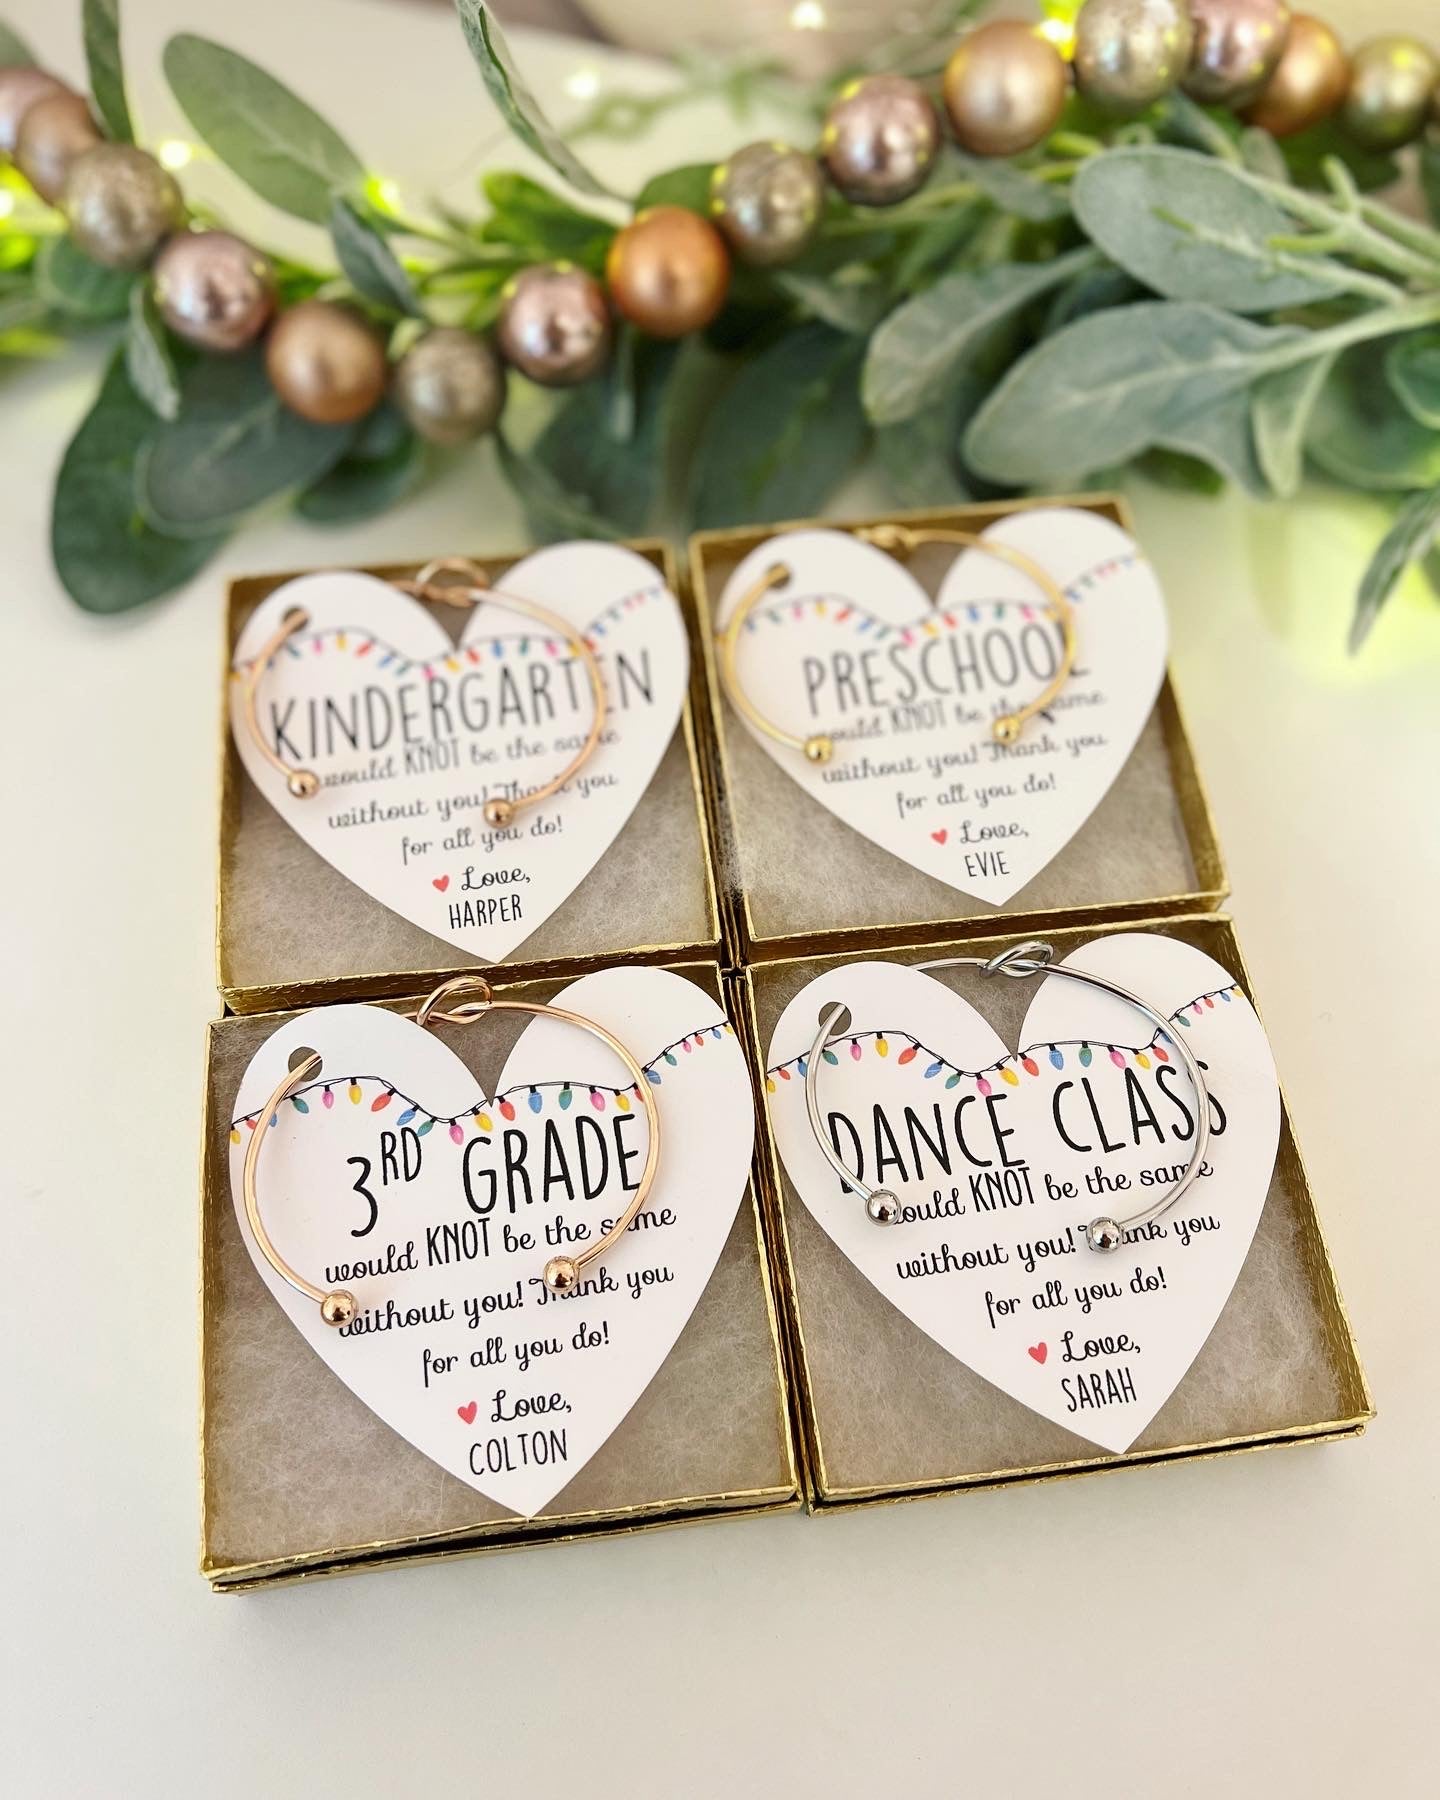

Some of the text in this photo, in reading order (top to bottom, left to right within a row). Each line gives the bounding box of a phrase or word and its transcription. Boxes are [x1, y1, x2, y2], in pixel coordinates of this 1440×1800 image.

[890, 697, 946, 734] KNOT
[956, 704, 983, 724] be
[323, 757, 397, 787] would
[405, 737, 459, 775] KNOT
[470, 744, 498, 765] be
[506, 737, 545, 760] the
[822, 734, 1107, 784] without you! Thank you
[328, 800, 428, 829] without
[437, 786, 487, 821] you!
[577, 773, 618, 798] you
[897, 773, 1057, 819] for all you do!
[402, 815, 563, 866] for all you do!
[960, 820, 1029, 844] Love,
[461, 866, 531, 891] Love,
[965, 851, 1010, 878] EVIE
[449, 894, 522, 929] HARPER
[463, 1114, 641, 1214] GRADE
[828, 1093, 1026, 1193] DANCE
[892, 1187, 966, 1225] ould
[968, 1166, 1035, 1212] KNOT
[1045, 1173, 1079, 1201] be
[1085, 1166, 1132, 1194] the
[326, 1241, 418, 1283] would
[426, 1217, 490, 1266] KNOT
[504, 1224, 536, 1252] be
[545, 1215, 591, 1245] the
[896, 1243, 1009, 1280] without
[1016, 1226, 1077, 1273] you!
[1174, 1215, 1221, 1246] you
[464, 1281, 524, 1329] you!
[627, 1266, 674, 1299] you
[985, 1266, 1168, 1329] for all you do!
[423, 1321, 610, 1388] for all you do!
[1060, 1330, 1141, 1362] Love,
[491, 1389, 572, 1423] Love,
[1061, 1367, 1137, 1412] SARAH
[469, 1428, 567, 1475] COLTON
